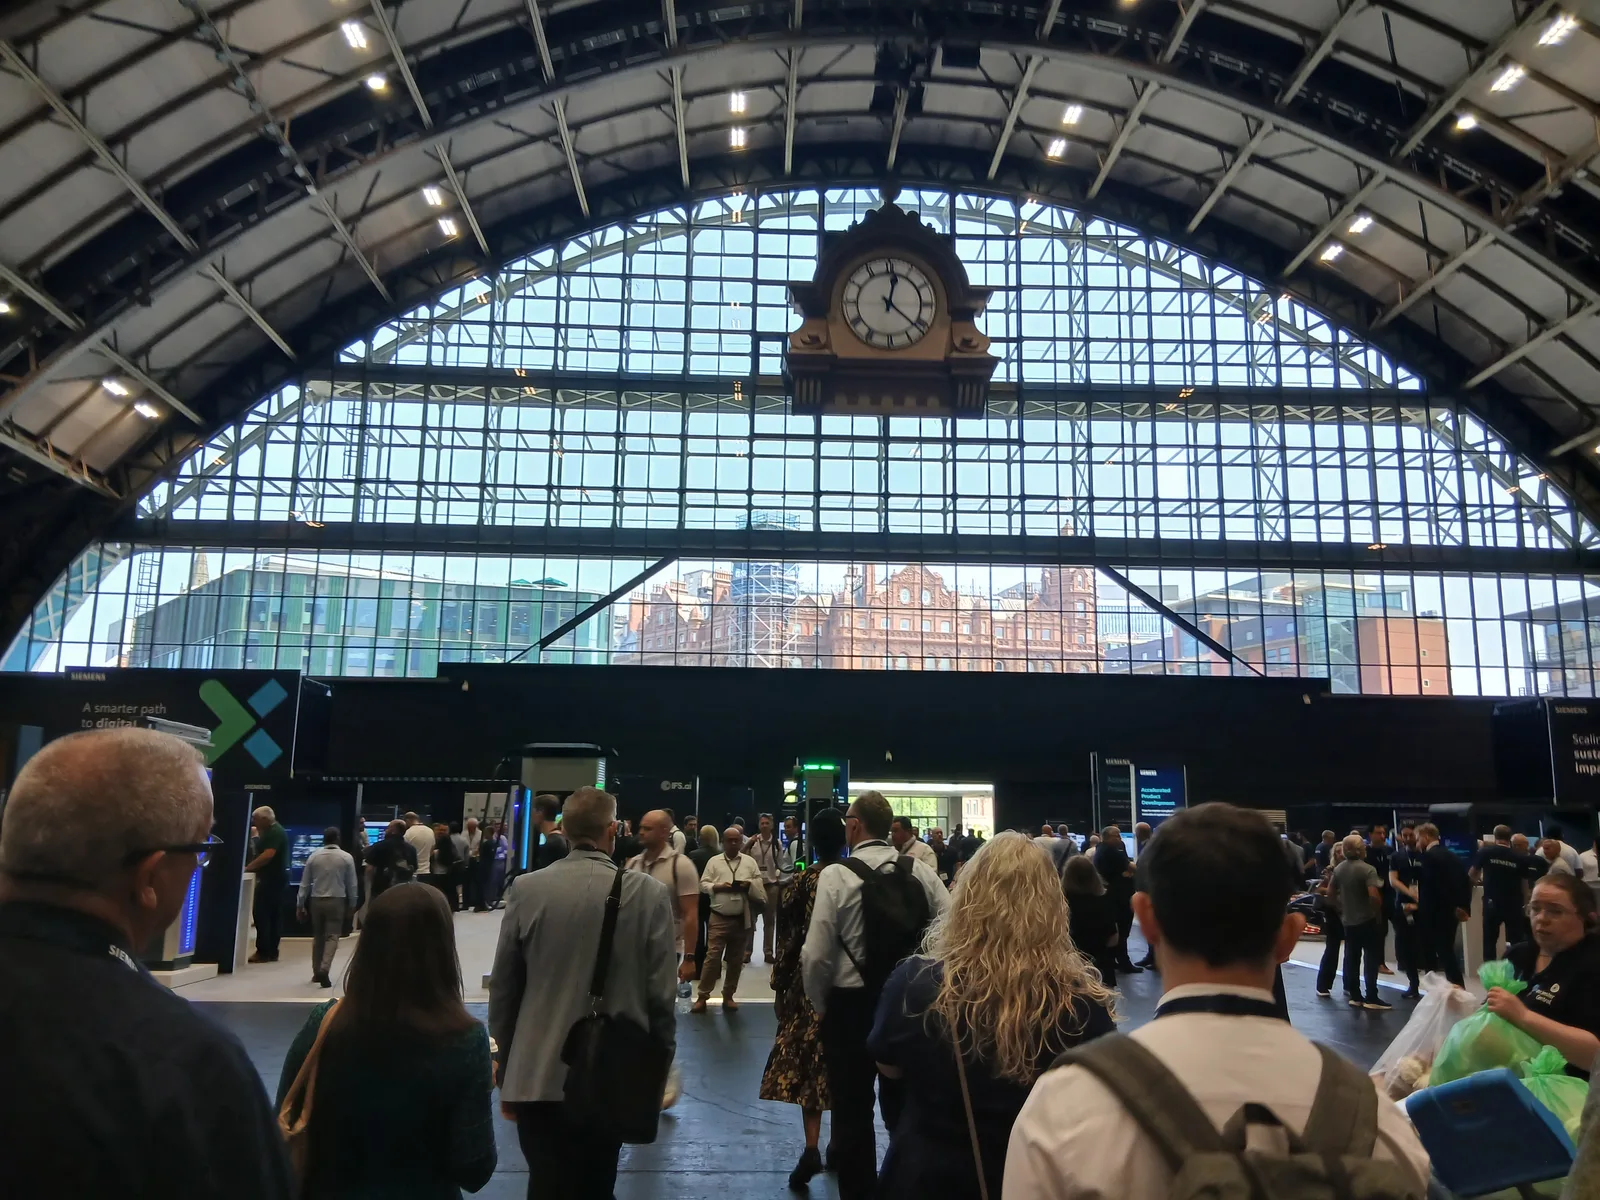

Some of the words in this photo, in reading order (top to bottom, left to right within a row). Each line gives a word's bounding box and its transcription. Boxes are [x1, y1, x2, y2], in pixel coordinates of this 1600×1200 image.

[70, 671, 106, 682] SIEMENS
[82, 702, 92, 713] A
[94, 703, 139, 714] smarter
[140, 702, 167, 717] path
[1554, 705, 1588, 715] SIEMENS
[81, 718, 93, 728] to
